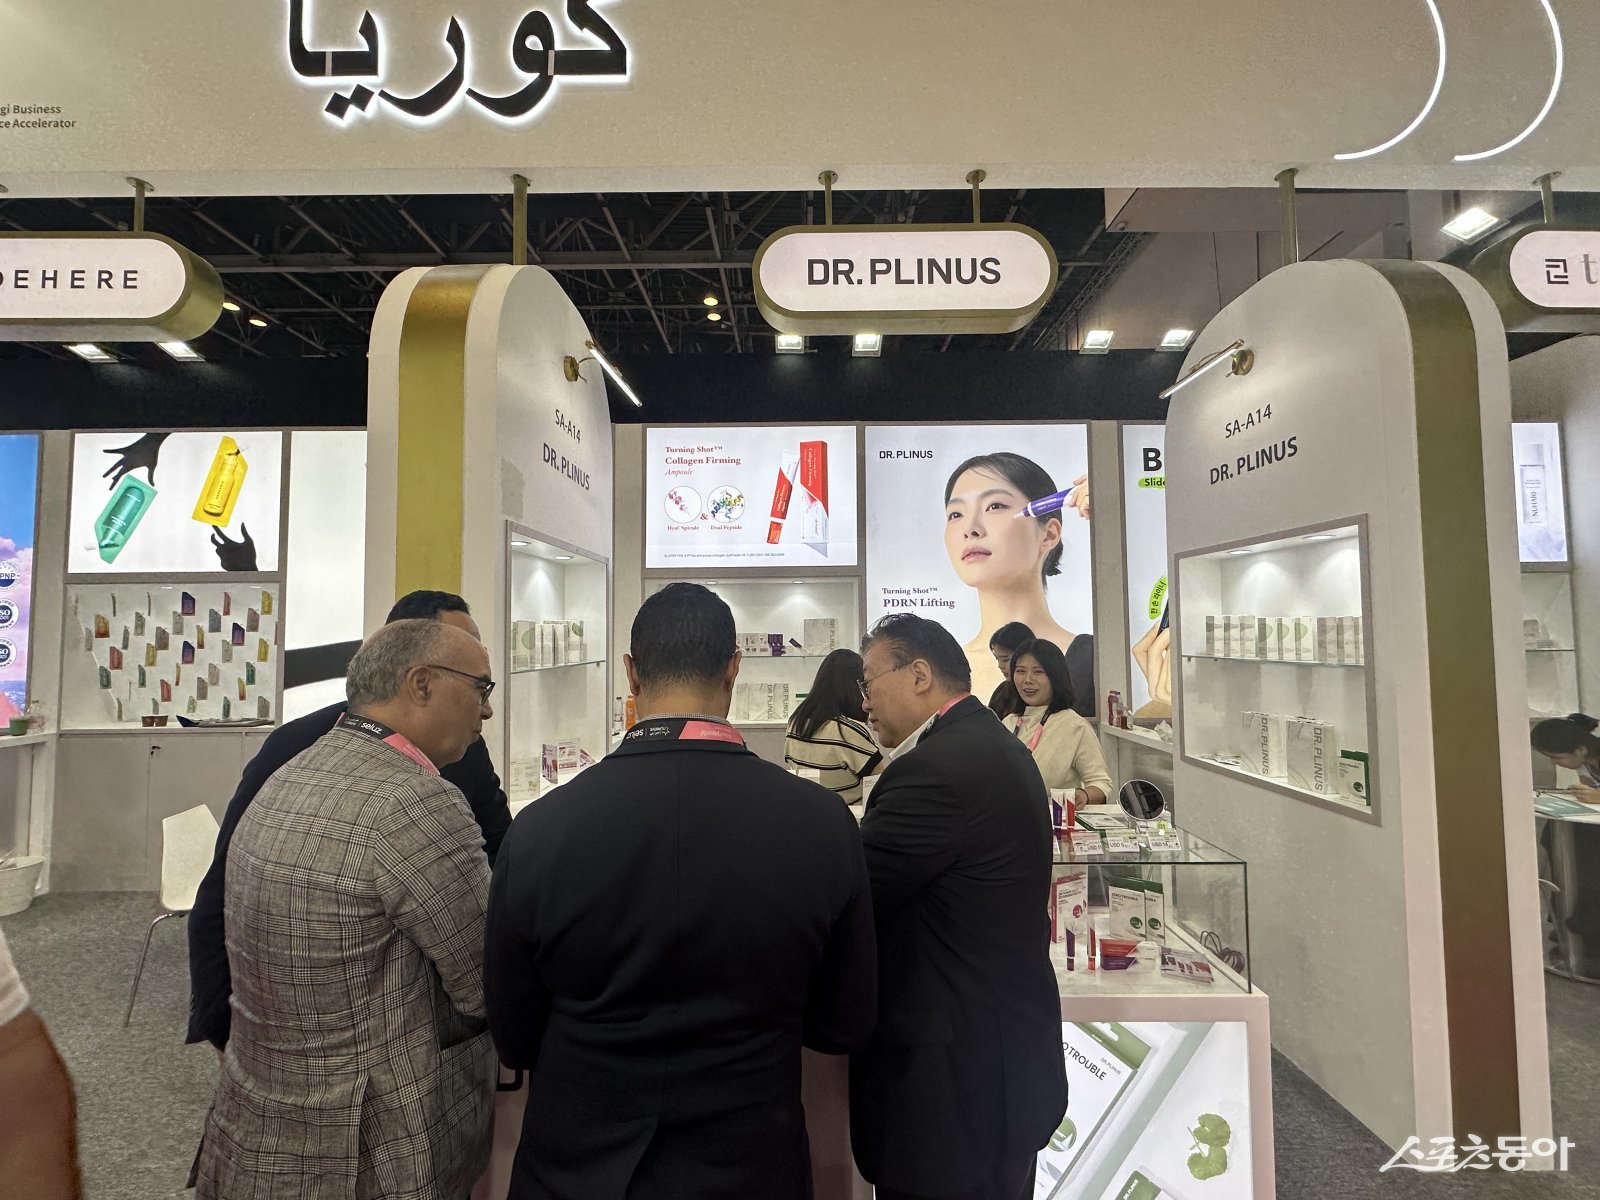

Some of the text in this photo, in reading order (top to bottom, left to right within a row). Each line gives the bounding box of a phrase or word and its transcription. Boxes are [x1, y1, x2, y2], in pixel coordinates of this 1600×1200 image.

[13, 104, 61, 114] Business
[12, 118, 77, 128] Accelerator
[0, 269, 139, 289] EHERE
[555, 408, 581, 444] SA-A14
[1225, 403, 1272, 438] SA-A14
[665, 446, 695, 455] Turning
[665, 456, 742, 467] Collagen Firming
[1210, 436, 1298, 485] DR. PLINUS
[543, 442, 590, 491] DR. PLINUS
[665, 468, 693, 477] Ampoule
[700, 512, 709, 520] &
[882, 587, 911, 596] Turning
[883, 597, 955, 609] PDRN Lifting
[1068, 1046, 1107, 1081] TROUBLE
